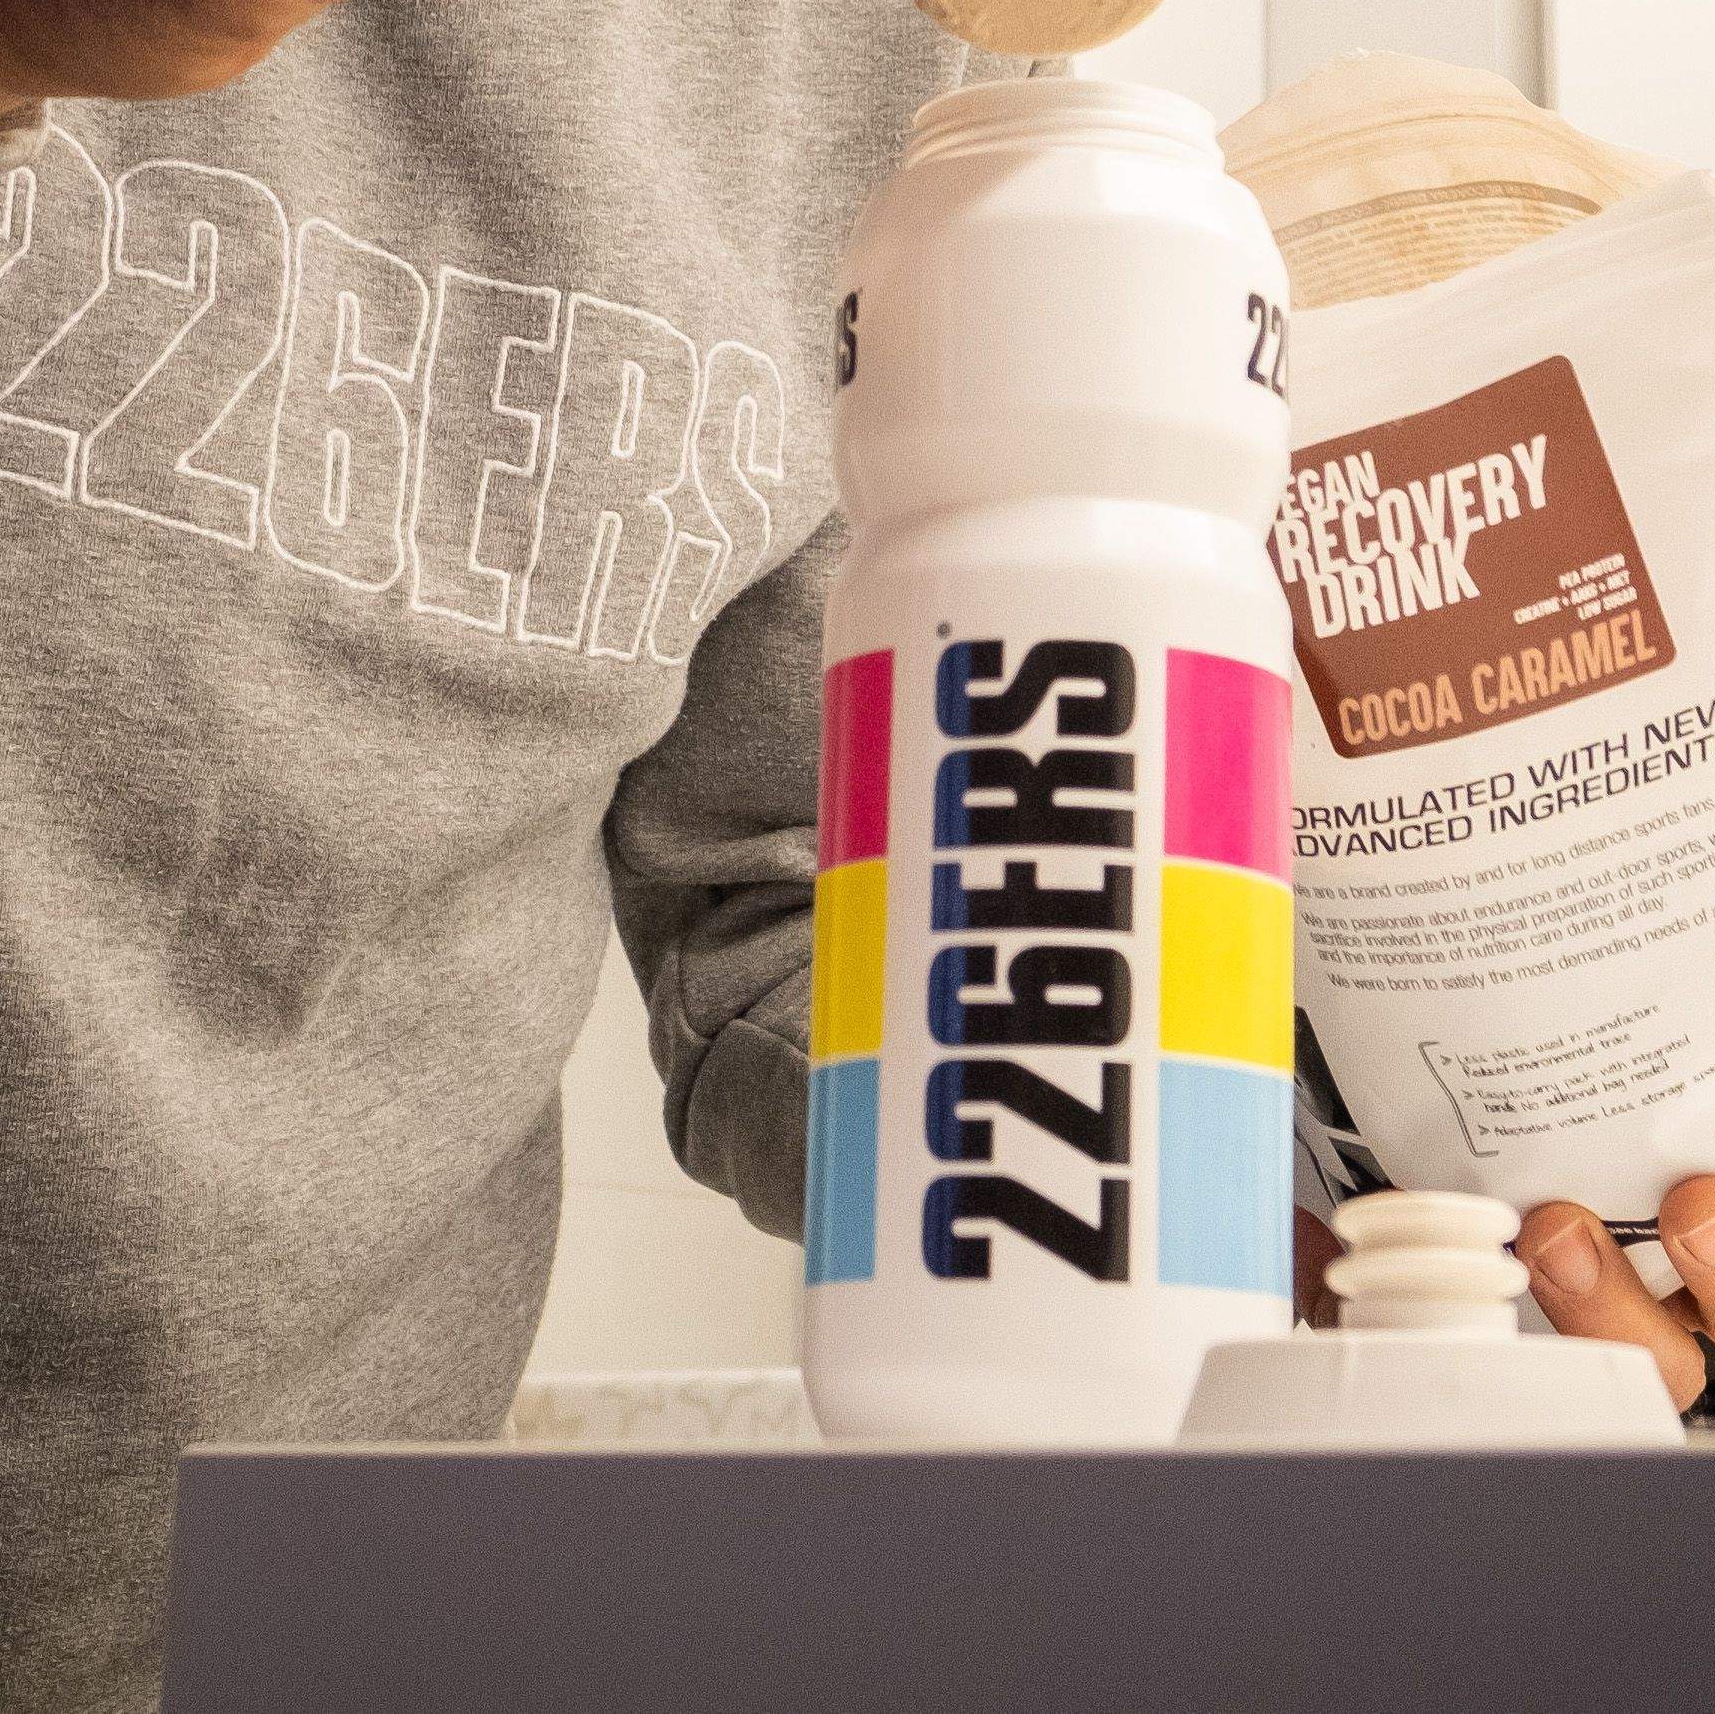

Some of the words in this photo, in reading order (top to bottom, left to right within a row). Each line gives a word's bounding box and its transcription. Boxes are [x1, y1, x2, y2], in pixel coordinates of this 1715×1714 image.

[1274, 433, 1548, 584] RECOVERY
[1285, 450, 1380, 520] EGAN
[1305, 537, 1480, 639] DRINK
[1339, 673, 1464, 747] COCOA
[1471, 609, 1658, 717] CARAMEL
[1292, 771, 1517, 832] ORMULATED
[1527, 731, 1630, 789] WITH
[1294, 815, 1473, 859] DVANCED
[1395, 874, 1449, 898] created
[1453, 873, 1470, 891] by
[1475, 865, 1505, 886] and
[1507, 859, 1528, 877] for
[1531, 849, 1566, 869] long
[1569, 827, 1632, 860] distance
[1634, 809, 1680, 838] sports
[1369, 949, 1447, 968] importance
[1450, 946, 1464, 962] of
[1467, 936, 1527, 960] nutrition
[1530, 928, 1563, 948] care
[1566, 913, 1615, 938] during
[1618, 904, 1634, 923] all
[1425, 930, 1439, 946] in
[1443, 927, 1466, 943] the
[1469, 917, 1529, 944] physical
[1531, 890, 1616, 929] preparation
[1619, 883, 1635, 902] of
[1637, 870, 1675, 896] such
[1429, 907, 1470, 927] about
[1474, 890, 1553, 921] endurance
[1556, 877, 1586, 901] and
[922, 638, 1137, 1284] 226ERS
[1423, 976, 1437, 991] to
[1489, 968, 1514, 985] the
[1516, 958, 1555, 981] most
[1558, 934, 1642, 971] demanding
[1644, 915, 1691, 945] needs
[1693, 907, 1709, 927] of
